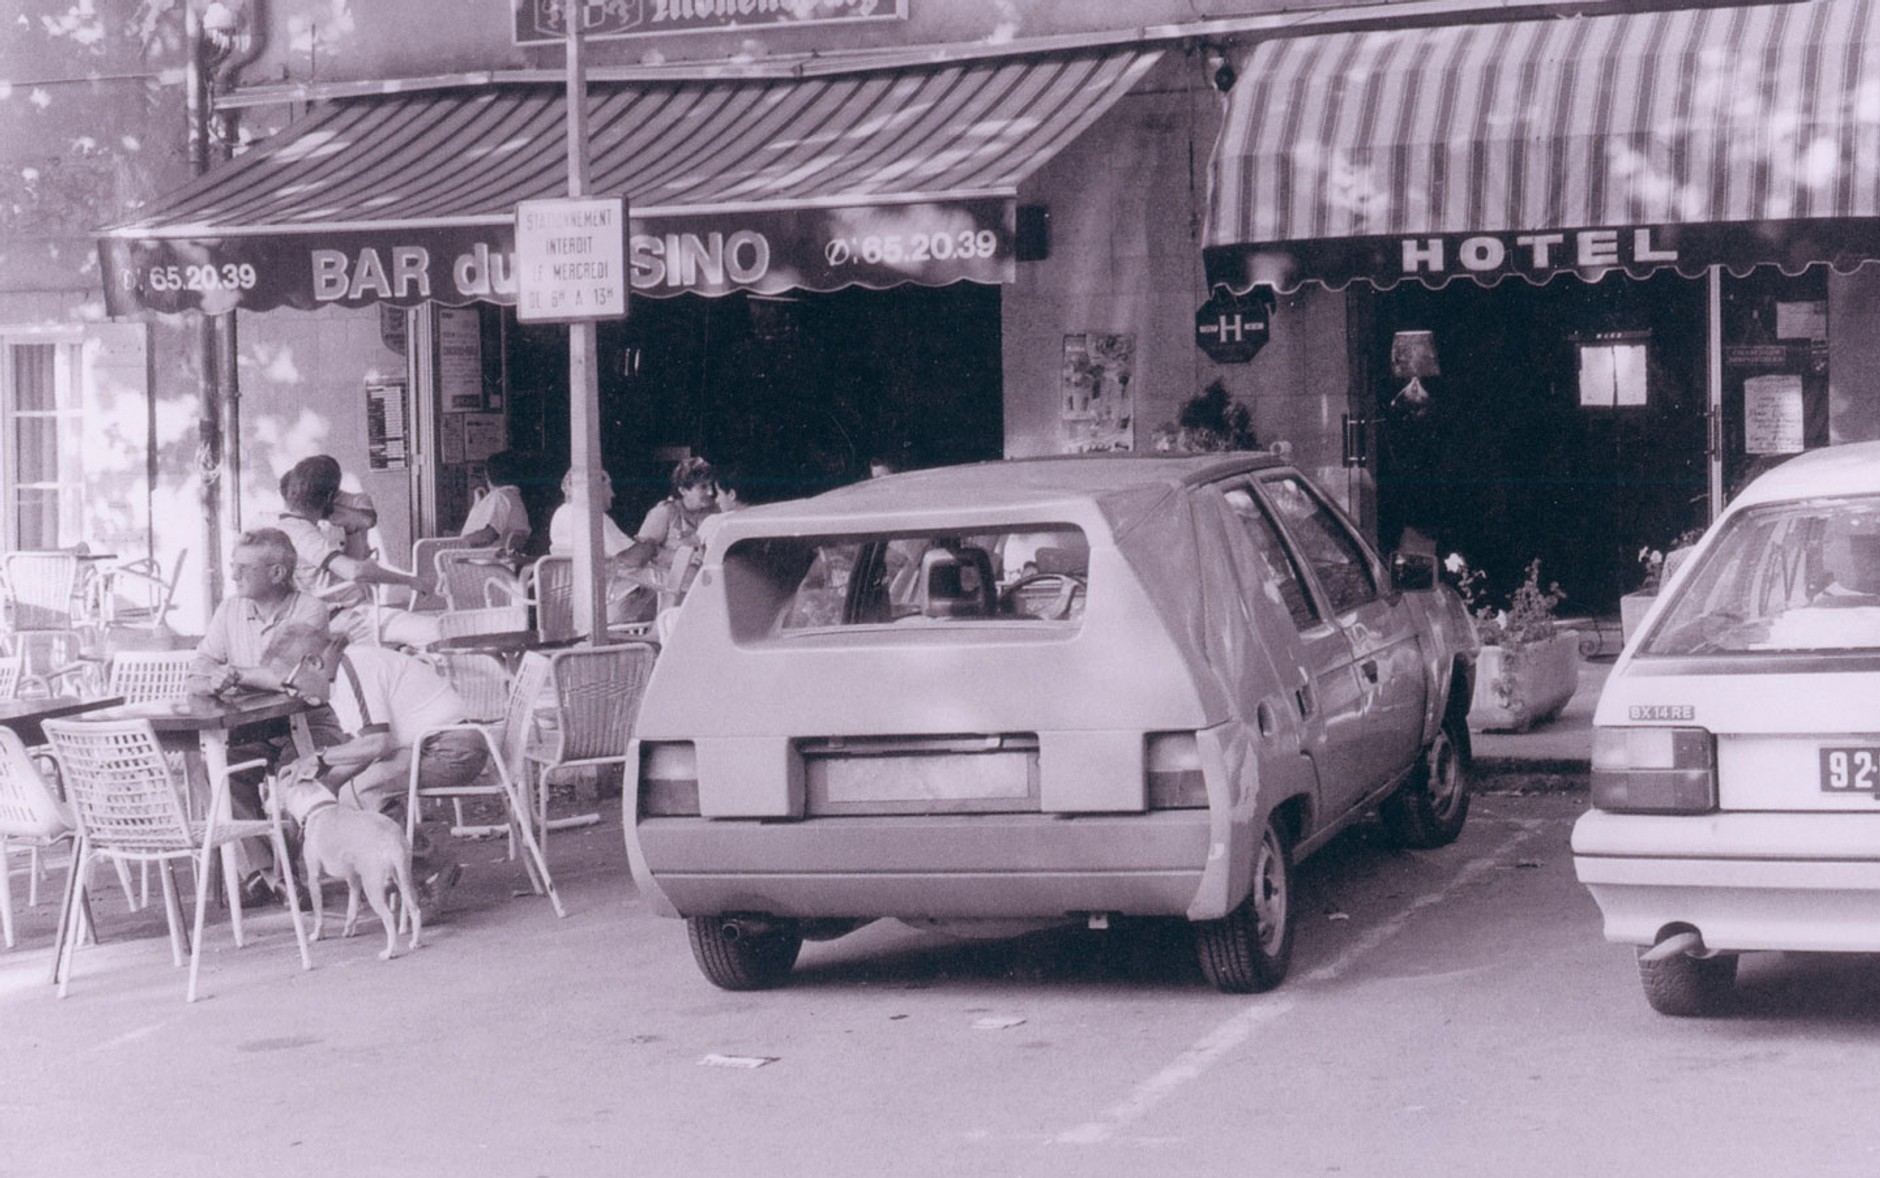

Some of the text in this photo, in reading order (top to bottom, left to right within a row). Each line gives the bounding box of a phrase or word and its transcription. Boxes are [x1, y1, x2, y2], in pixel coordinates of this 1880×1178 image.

[526, 208, 612, 231] STATNNEMENT
[545, 236, 592, 255] INTERDIT
[861, 230, 997, 264] 65.20.39
[1402, 228, 1679, 272] HOTEL
[150, 263, 257, 291] 65.20.39
[312, 229, 770, 300] BAR du SINO
[553, 261, 608, 281] MERCREDI
[1829, 751, 1880, 788] 92
